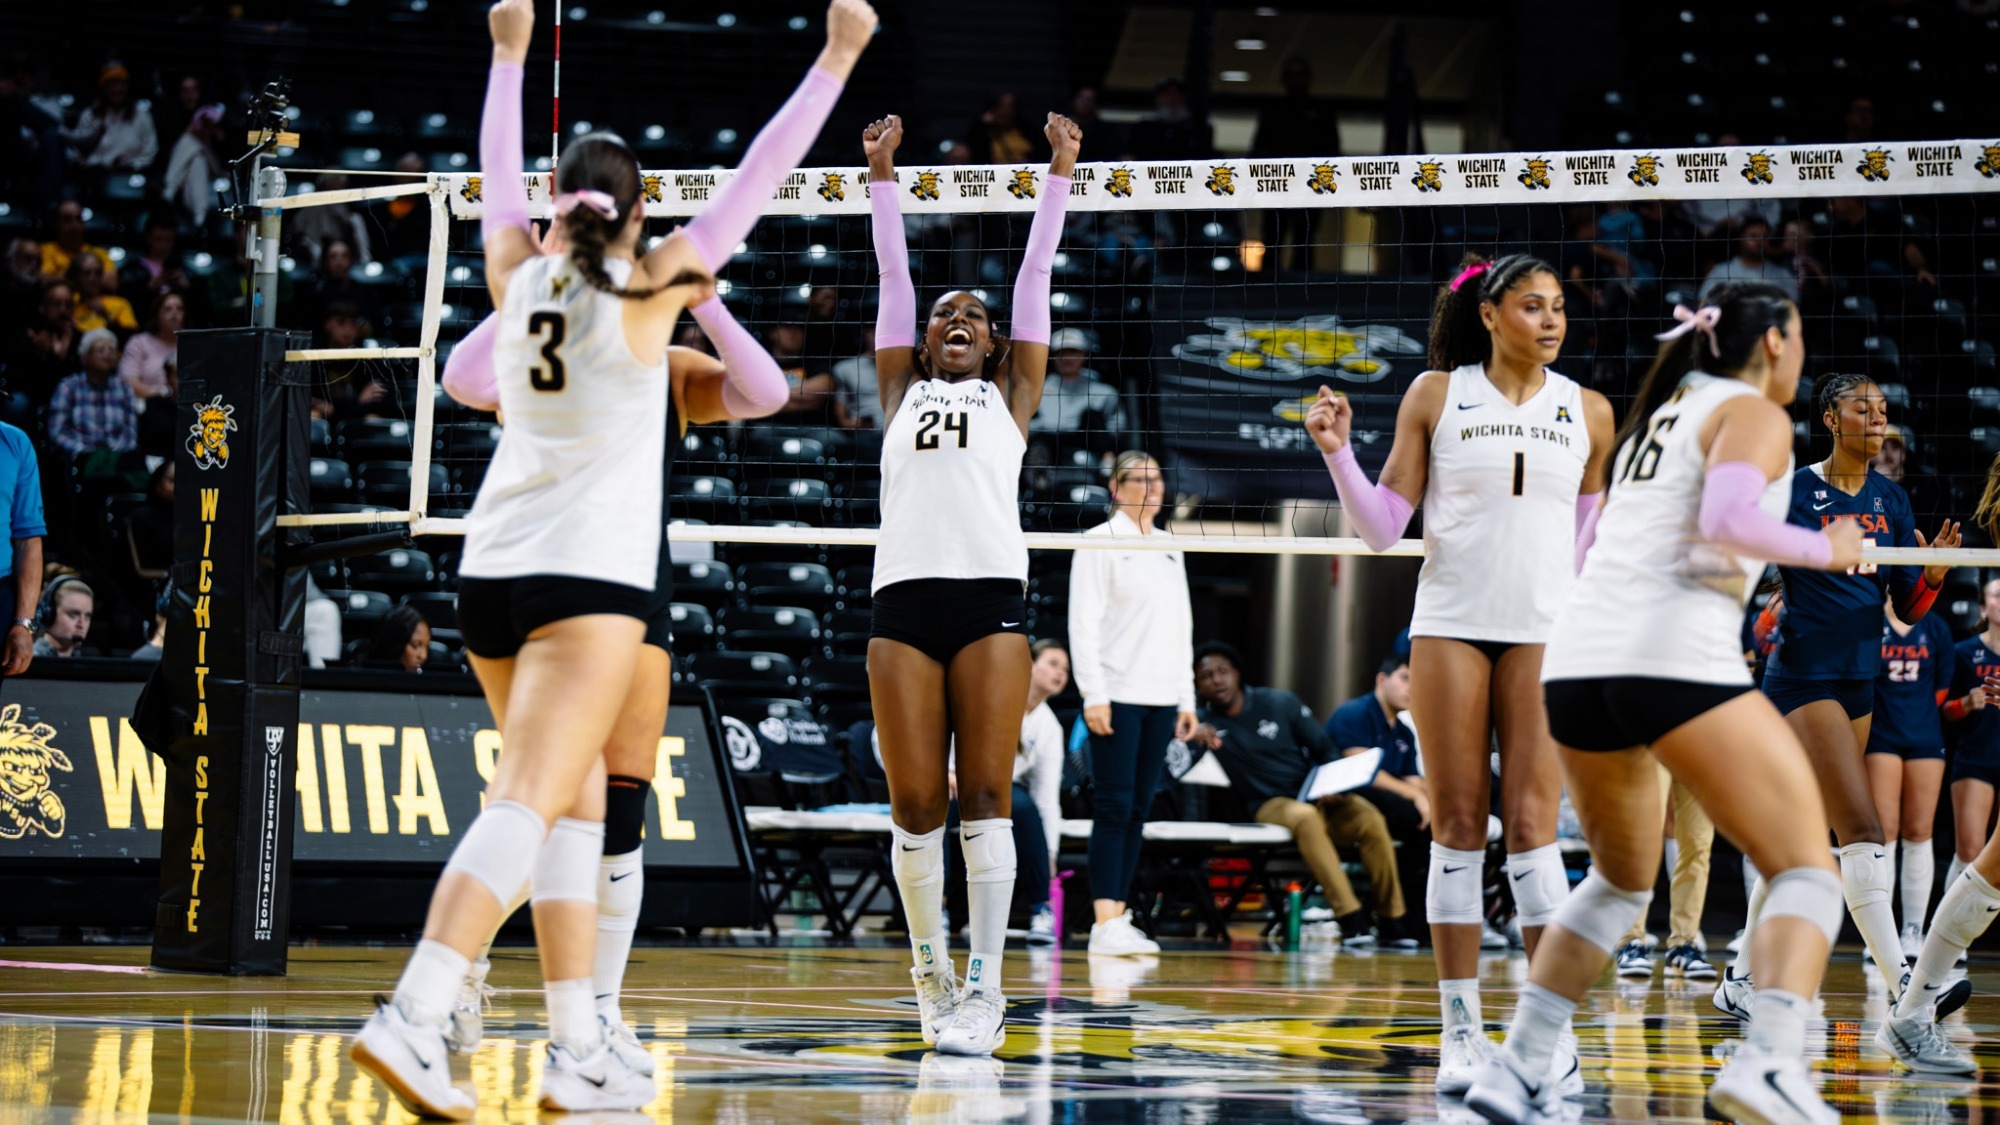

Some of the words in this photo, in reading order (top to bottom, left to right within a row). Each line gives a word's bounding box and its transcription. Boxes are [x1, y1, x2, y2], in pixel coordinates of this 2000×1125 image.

[1676, 153, 1728, 168] WICHITA
[1790, 150, 1844, 165] WICHITA
[1907, 146, 1962, 161] WICHITA
[1352, 161, 1400, 176] WICHITA
[1457, 158, 1506, 173] WICHITA
[1565, 155, 1616, 170] WICHITA
[1915, 161, 1954, 177] STATE
[953, 170, 996, 184] WICHITA
[1072, 167, 1095, 181] HITA
[1147, 165, 1193, 180] WICHITA
[1249, 163, 1296, 178] WICHITA
[1684, 168, 1720, 183] STATE
[1798, 165, 1836, 180] STATE
[674, 174, 716, 187] WICHITA
[785, 172, 807, 186] HITA
[1257, 178, 1289, 193] STATE
[1359, 176, 1392, 191] STATE
[1465, 174, 1499, 188] STATE
[1573, 171, 1609, 186] STATE
[681, 187, 709, 201] STATE
[960, 184, 989, 198] STATE
[1069, 182, 1087, 196] ATE
[1154, 180, 1186, 194] STATE
[528, 310, 566, 392] 3
[915, 410, 968, 451] 24
[1460, 424, 1524, 441] WICHITA
[1530, 427, 1571, 449] STATE
[1618, 412, 1680, 485] 16
[1512, 451, 1525, 497] 1
[1819, 513, 1889, 534] SA
[193, 488, 219, 736] WICHITA
[1881, 644, 1930, 659] UTSA
[1888, 660, 1920, 682] 23
[90, 716, 450, 835] WITA
[187, 756, 209, 933] STATE
